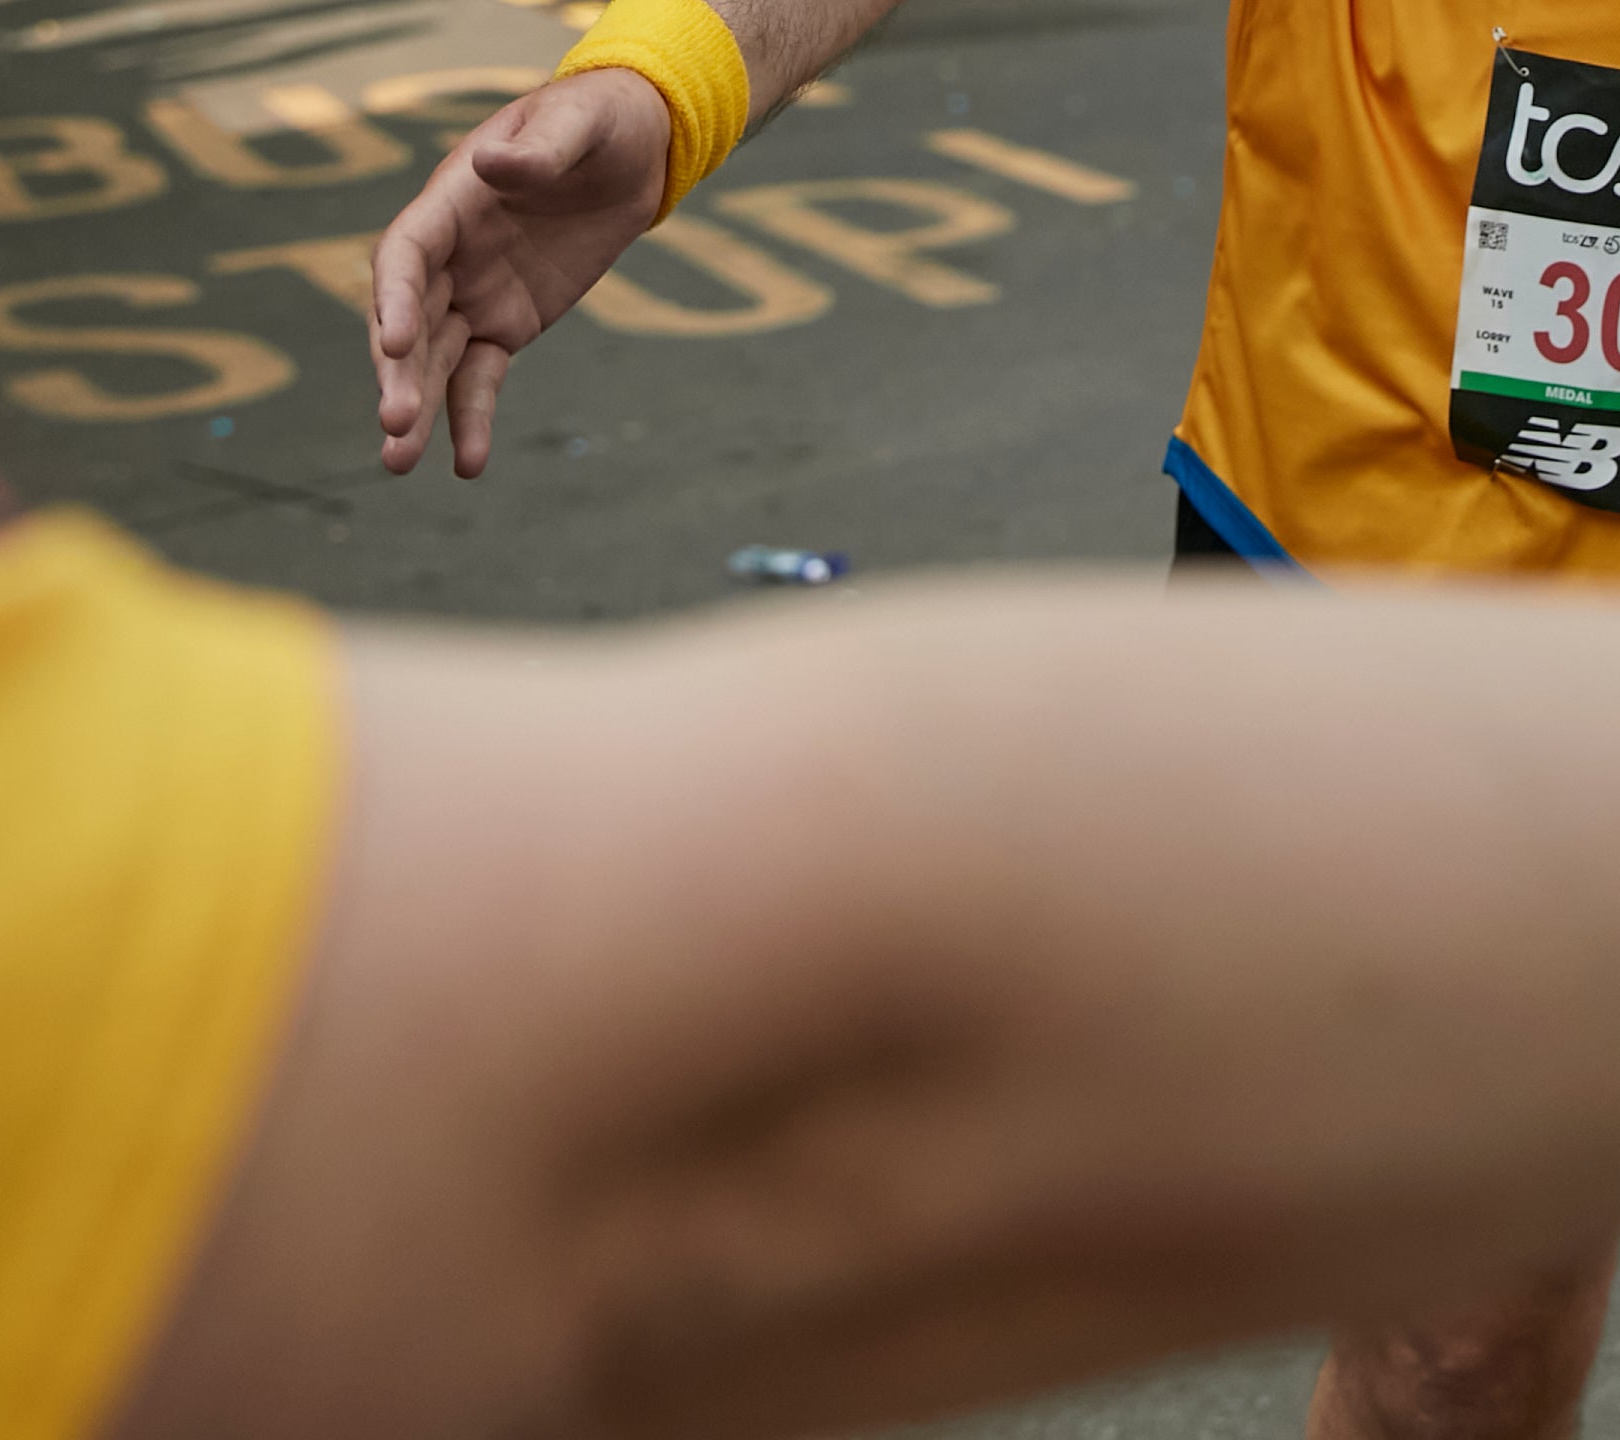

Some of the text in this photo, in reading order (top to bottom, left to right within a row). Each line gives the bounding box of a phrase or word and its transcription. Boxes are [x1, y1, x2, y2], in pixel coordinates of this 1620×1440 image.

[1482, 285, 1514, 300] WAVE
[1476, 329, 1511, 344] LORRY
[1544, 385, 1594, 406] MEDAL
